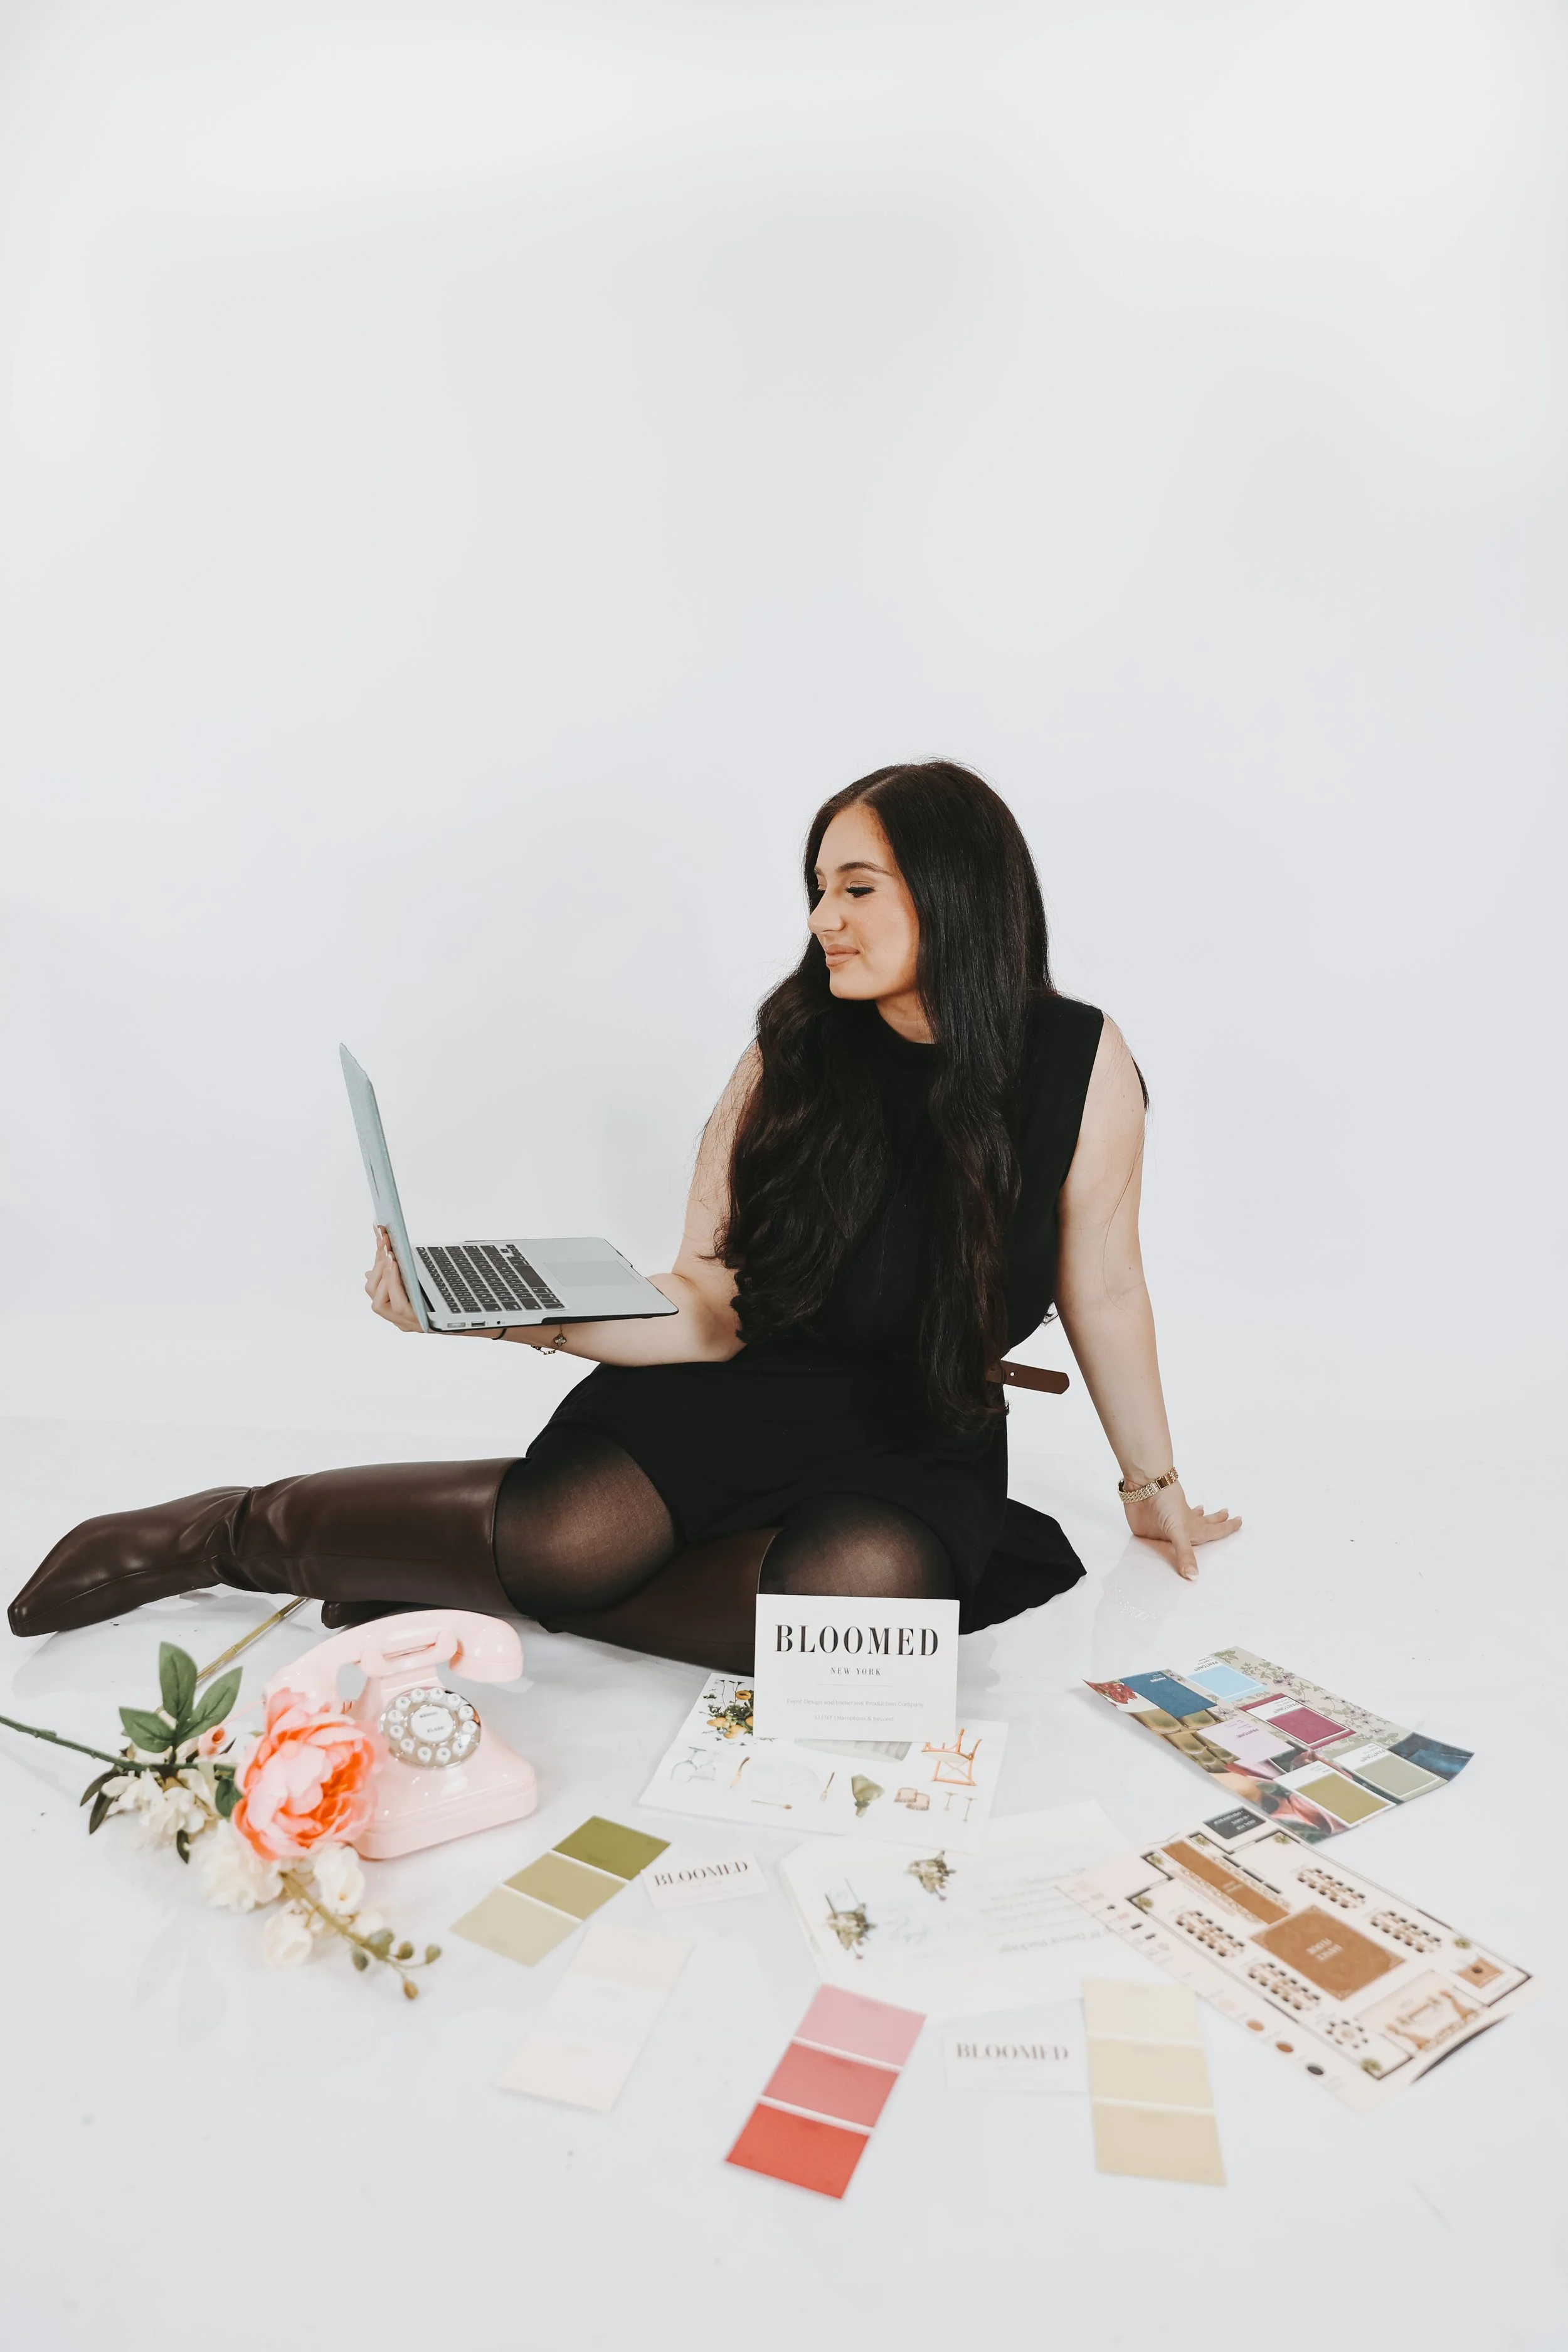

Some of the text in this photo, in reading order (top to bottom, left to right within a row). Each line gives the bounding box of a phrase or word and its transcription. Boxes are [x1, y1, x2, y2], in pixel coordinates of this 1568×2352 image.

[775, 1624, 938, 1656] BLOOMED
[898, 1701, 924, 1709] Company
[654, 1860, 748, 1886] BLOOMED
[956, 2042, 1069, 2060] BLOOMED
